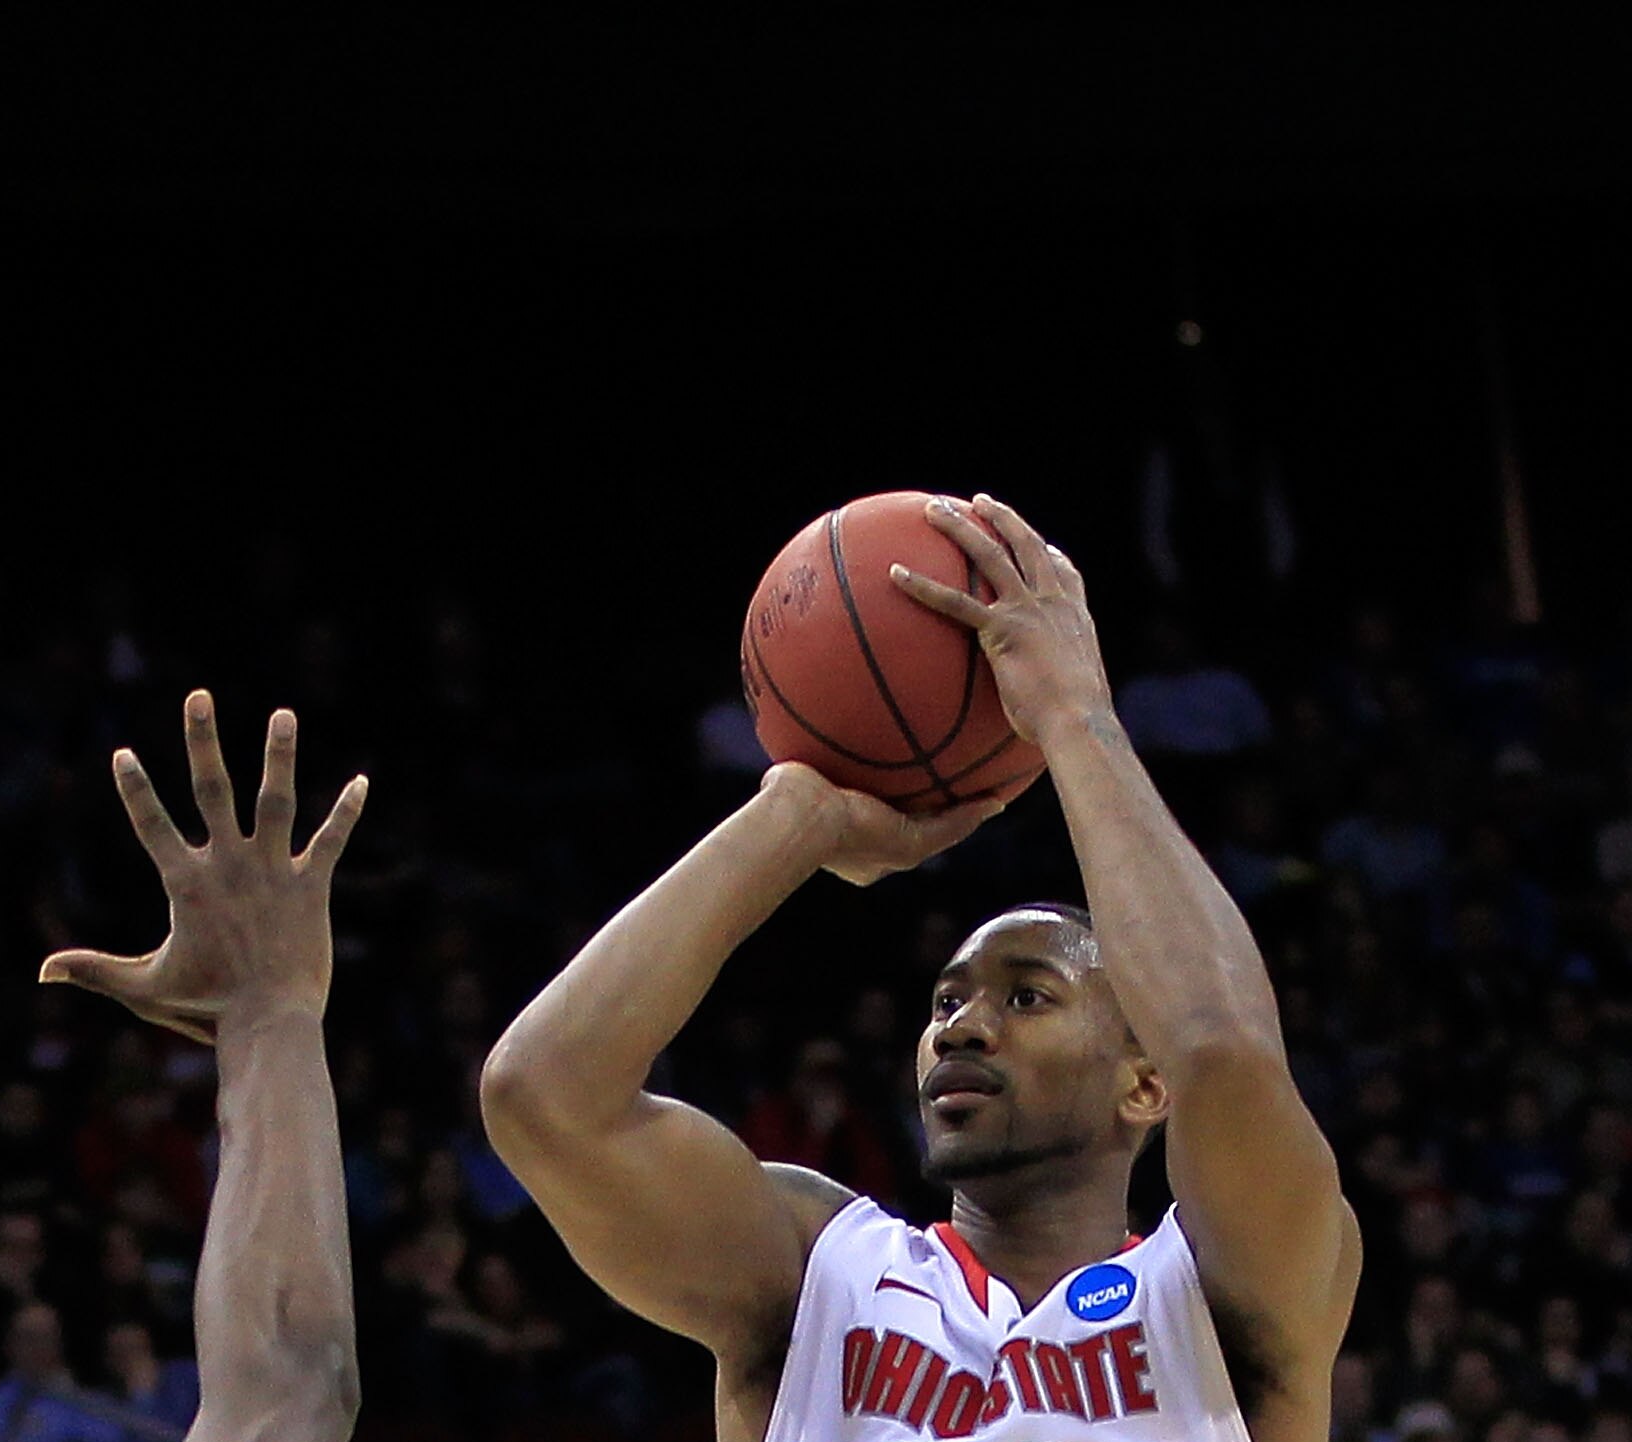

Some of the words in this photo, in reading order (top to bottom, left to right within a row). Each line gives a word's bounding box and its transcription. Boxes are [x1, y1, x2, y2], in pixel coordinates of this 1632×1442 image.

[1077, 1283, 1128, 1312] NCAA
[842, 1326, 986, 1439] OHIO
[980, 1321, 1161, 1428] STATE
